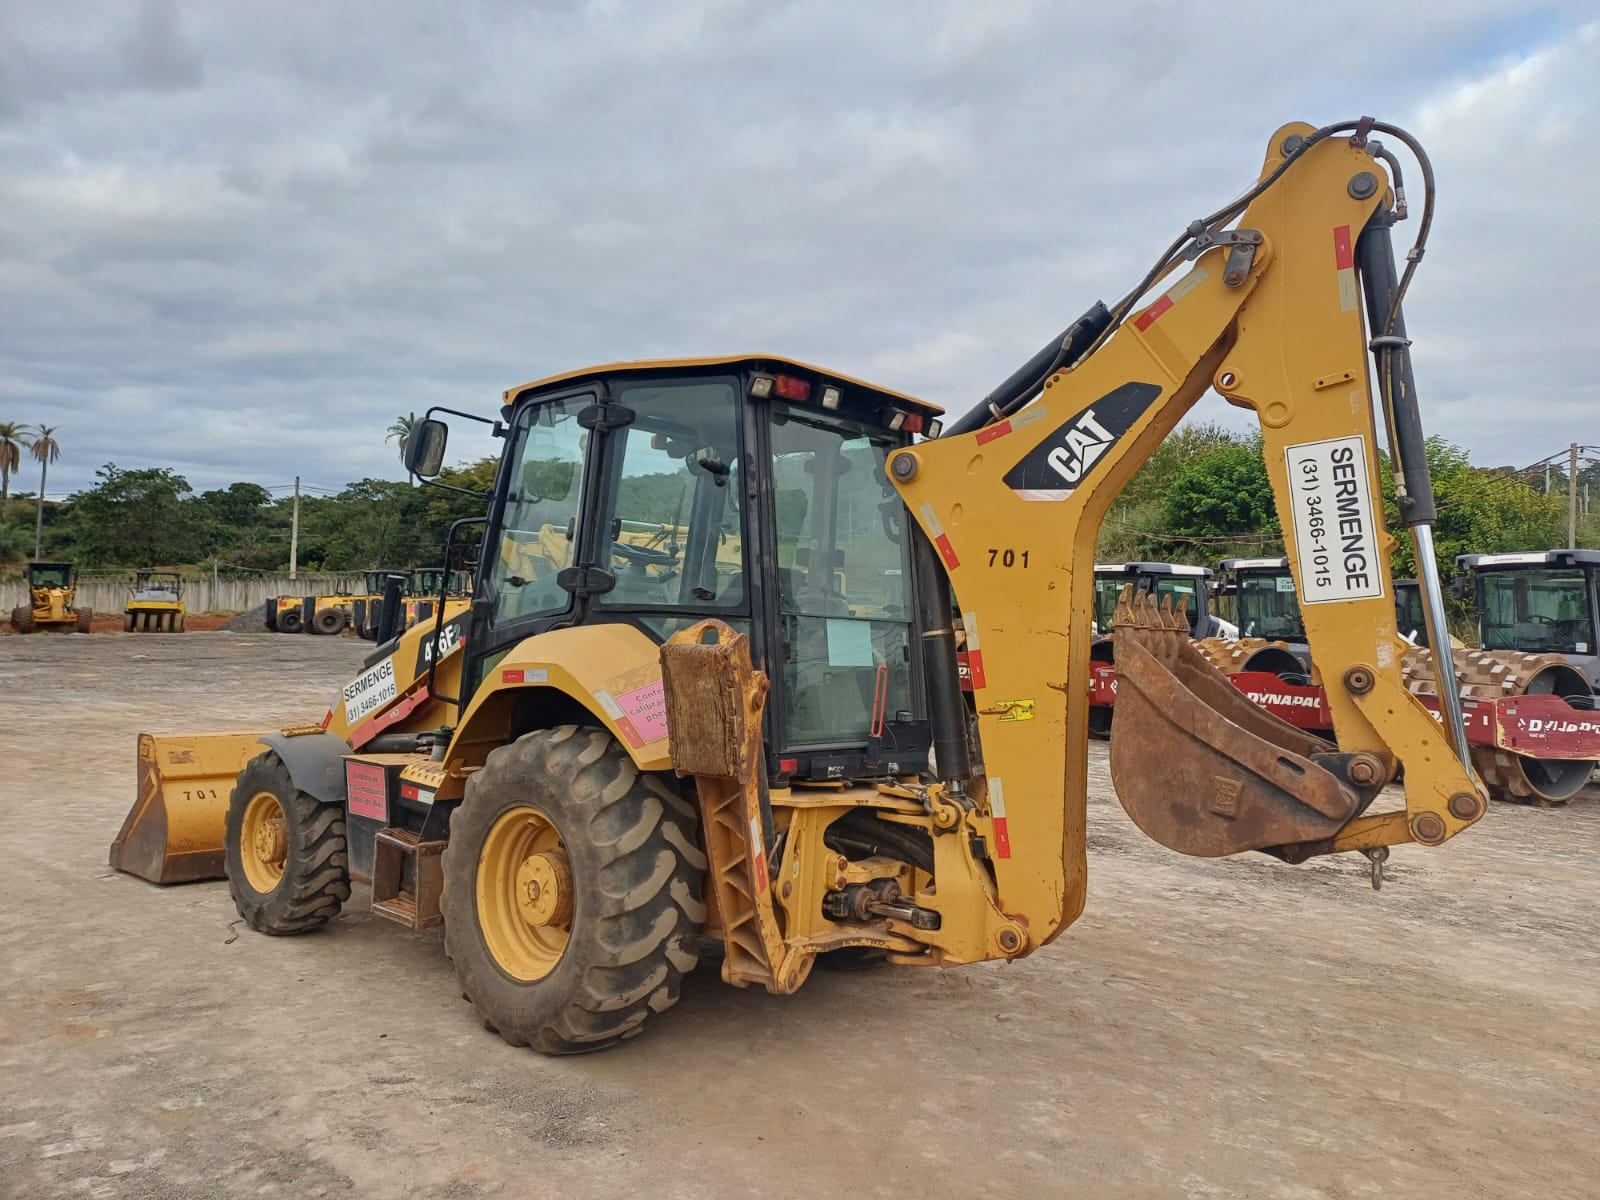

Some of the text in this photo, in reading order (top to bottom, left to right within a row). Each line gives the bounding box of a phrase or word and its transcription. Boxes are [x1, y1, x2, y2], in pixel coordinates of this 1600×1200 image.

[1048, 409, 1115, 482] CAT
[1299, 458, 1331, 587] (31) 3466-1015
[1330, 447, 1369, 590] SERMENGE
[988, 549, 1029, 568] 701
[344, 661, 393, 702] SERMENGE
[347, 683, 396, 722] (31) 3466-1015
[182, 789, 217, 801] 701
